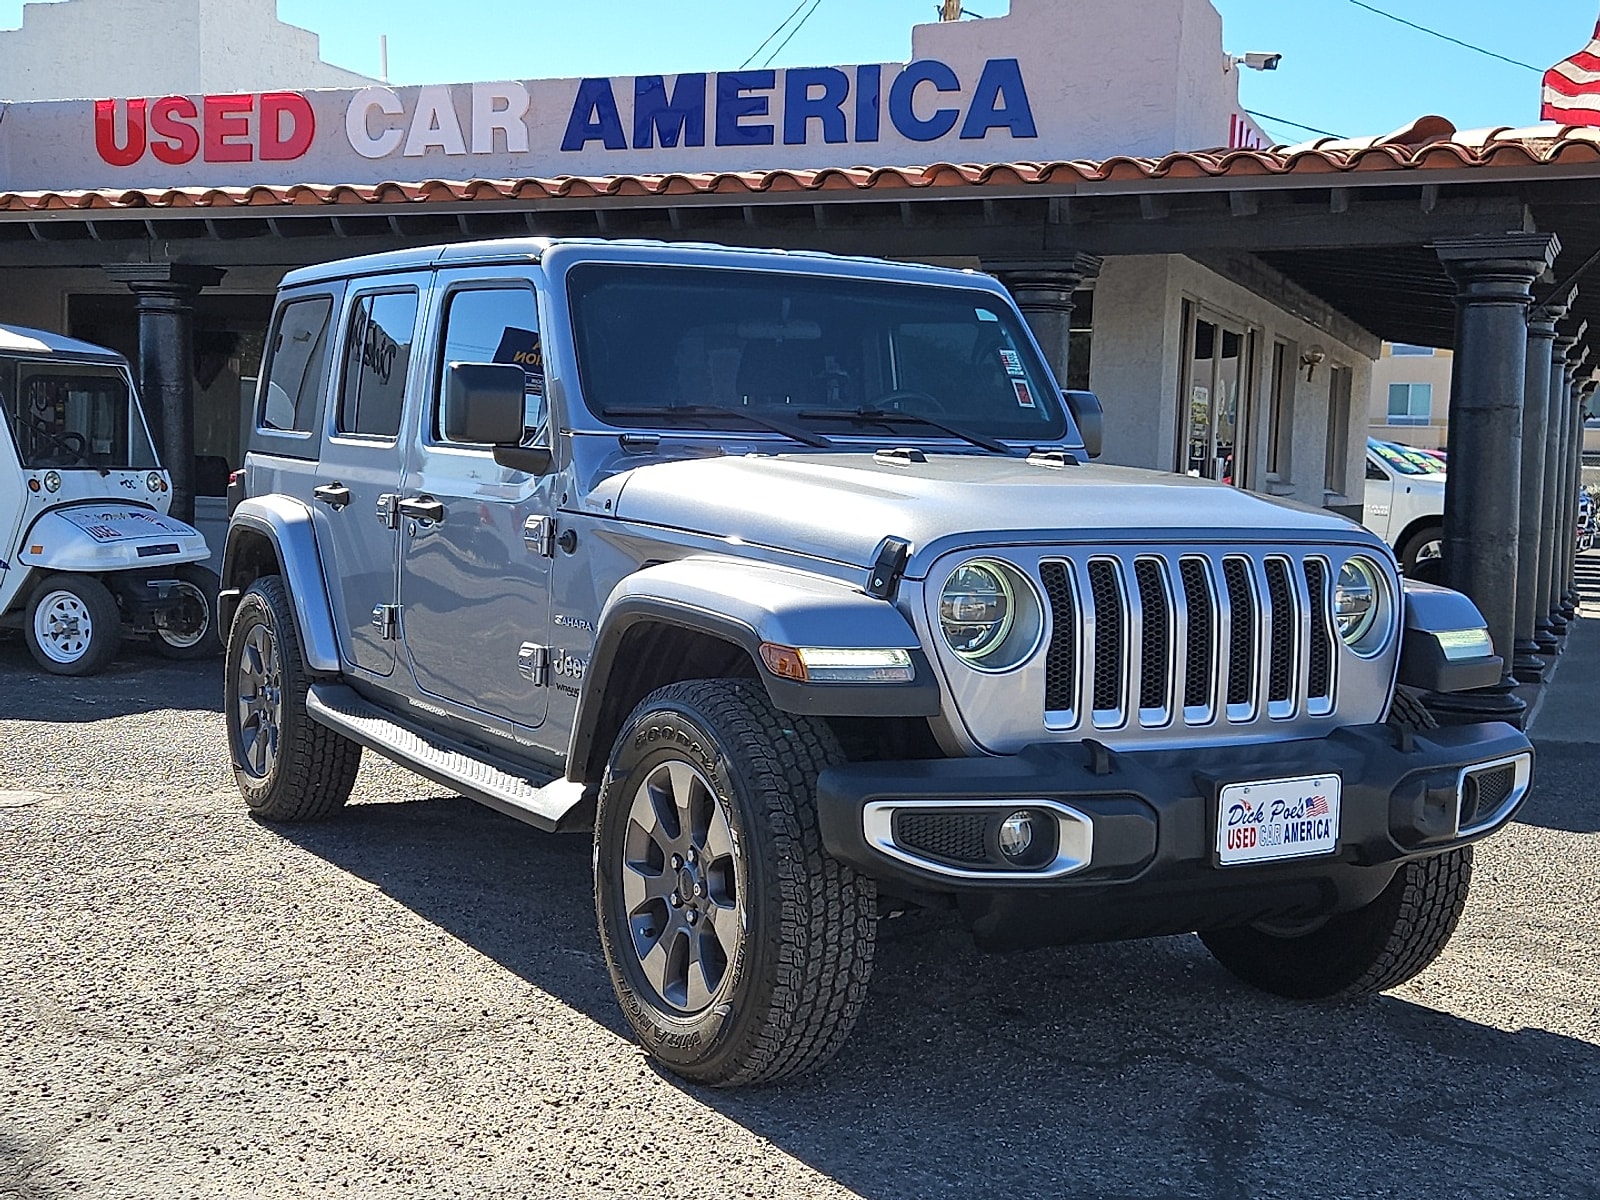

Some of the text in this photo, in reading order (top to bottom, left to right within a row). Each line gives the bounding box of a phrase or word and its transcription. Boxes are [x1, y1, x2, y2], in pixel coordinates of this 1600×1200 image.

[95, 58, 1038, 166] USED CAR AMERICA
[1228, 798, 1305, 826] Dick Poe's
[1228, 819, 1330, 849] USED CAR AMERICA
